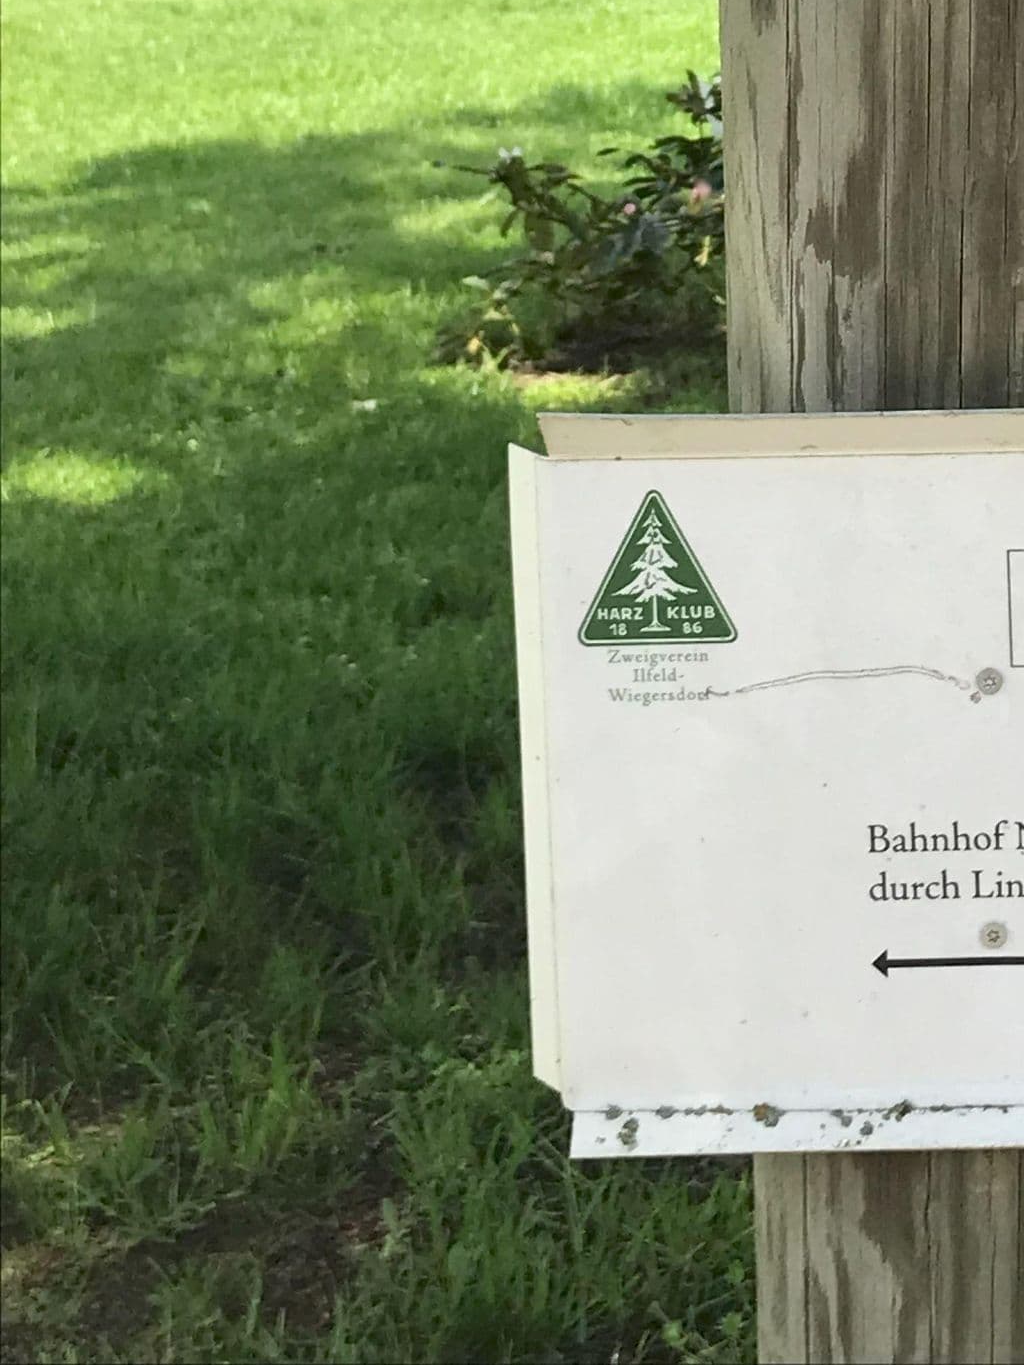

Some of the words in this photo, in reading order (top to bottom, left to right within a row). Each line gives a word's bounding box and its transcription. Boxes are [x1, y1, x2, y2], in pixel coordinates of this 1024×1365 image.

[597, 607, 644, 621] HARZ
[667, 605, 716, 619] KLUB
[609, 622, 628, 636] 18
[682, 621, 703, 634] 86
[607, 649, 709, 667] Zweigverein
[632, 668, 685, 682] Ilfeld-
[867, 819, 1009, 854] Bahnhof
[869, 869, 961, 902] durch
